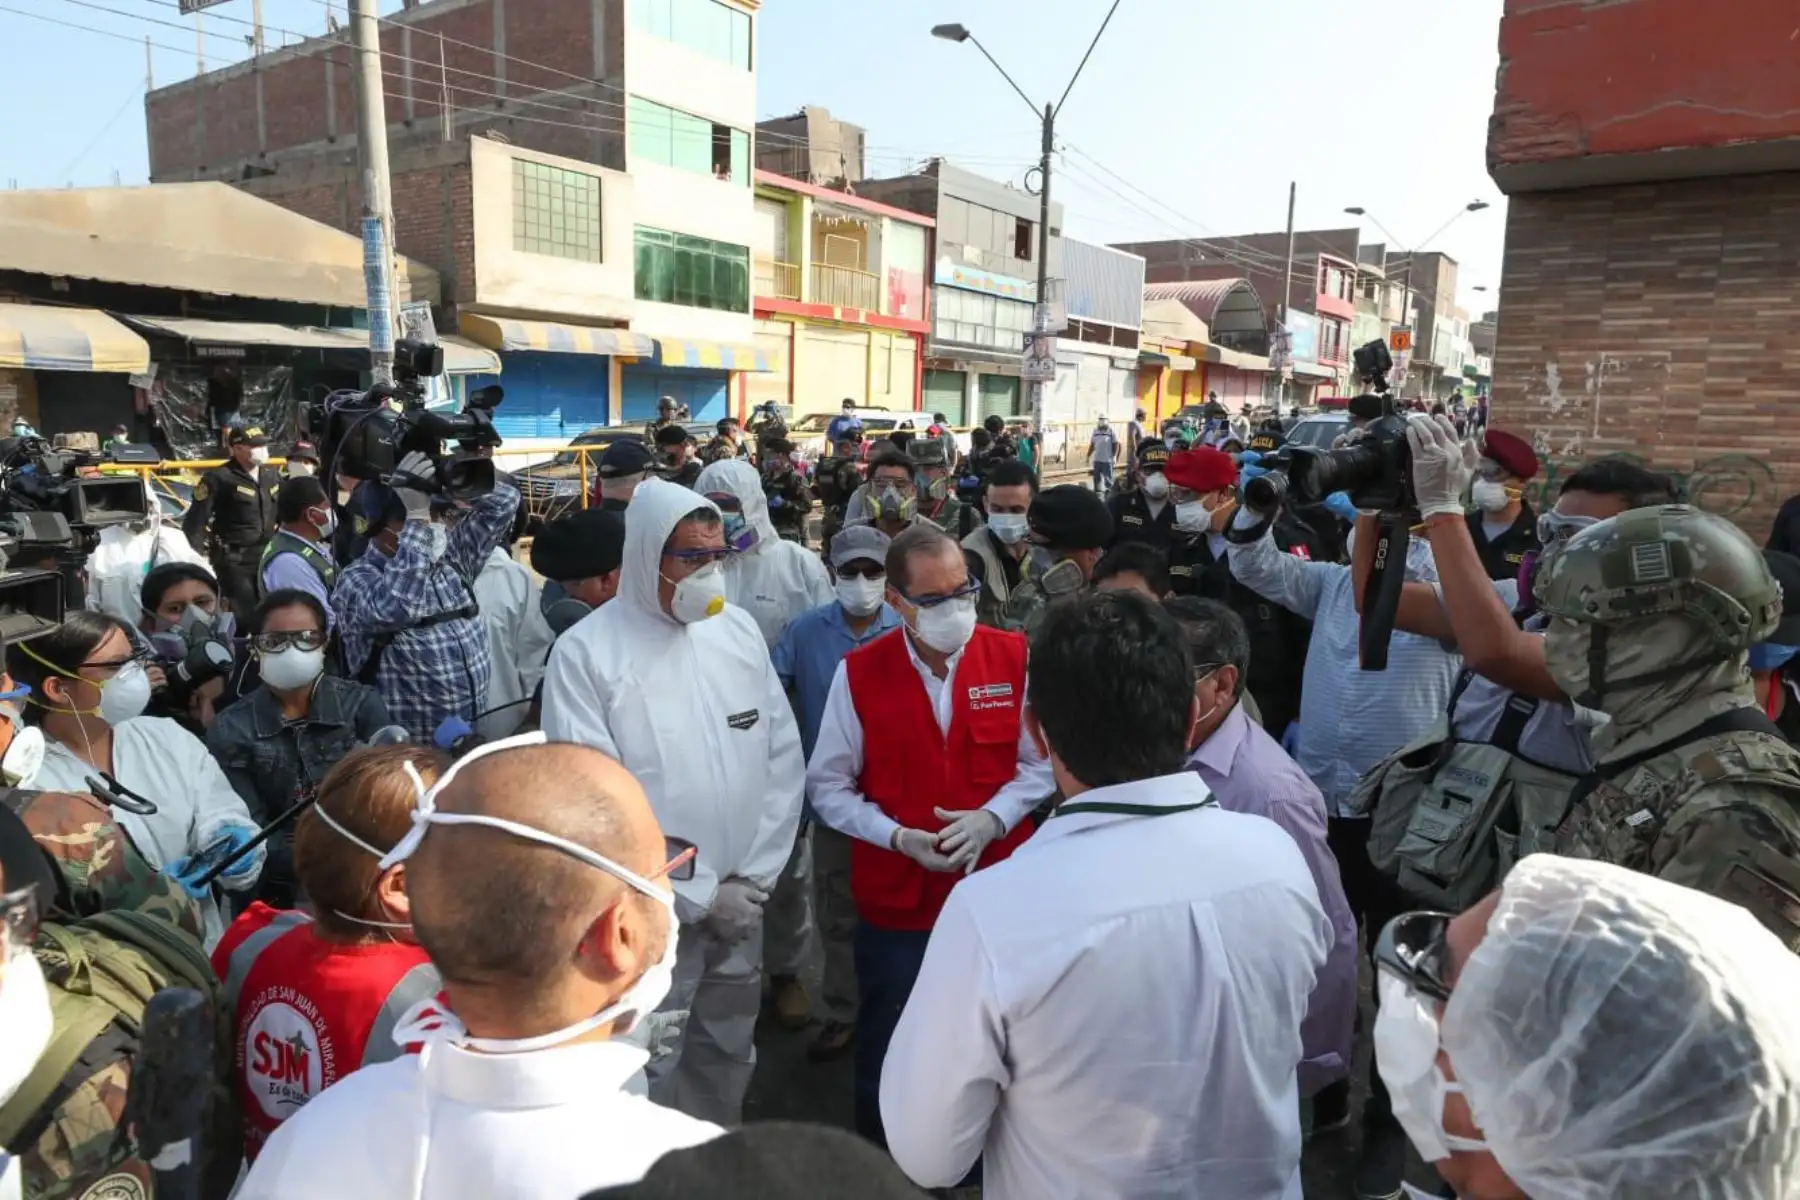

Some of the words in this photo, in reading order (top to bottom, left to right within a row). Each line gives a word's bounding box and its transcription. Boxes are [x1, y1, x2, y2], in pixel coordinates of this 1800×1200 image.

[267, 985, 278, 1000] DE
[279, 986, 296, 1002] SAN
[297, 993, 319, 1020] JUAN
[314, 1015, 326, 1037] DE
[252, 1031, 310, 1096] SJM
